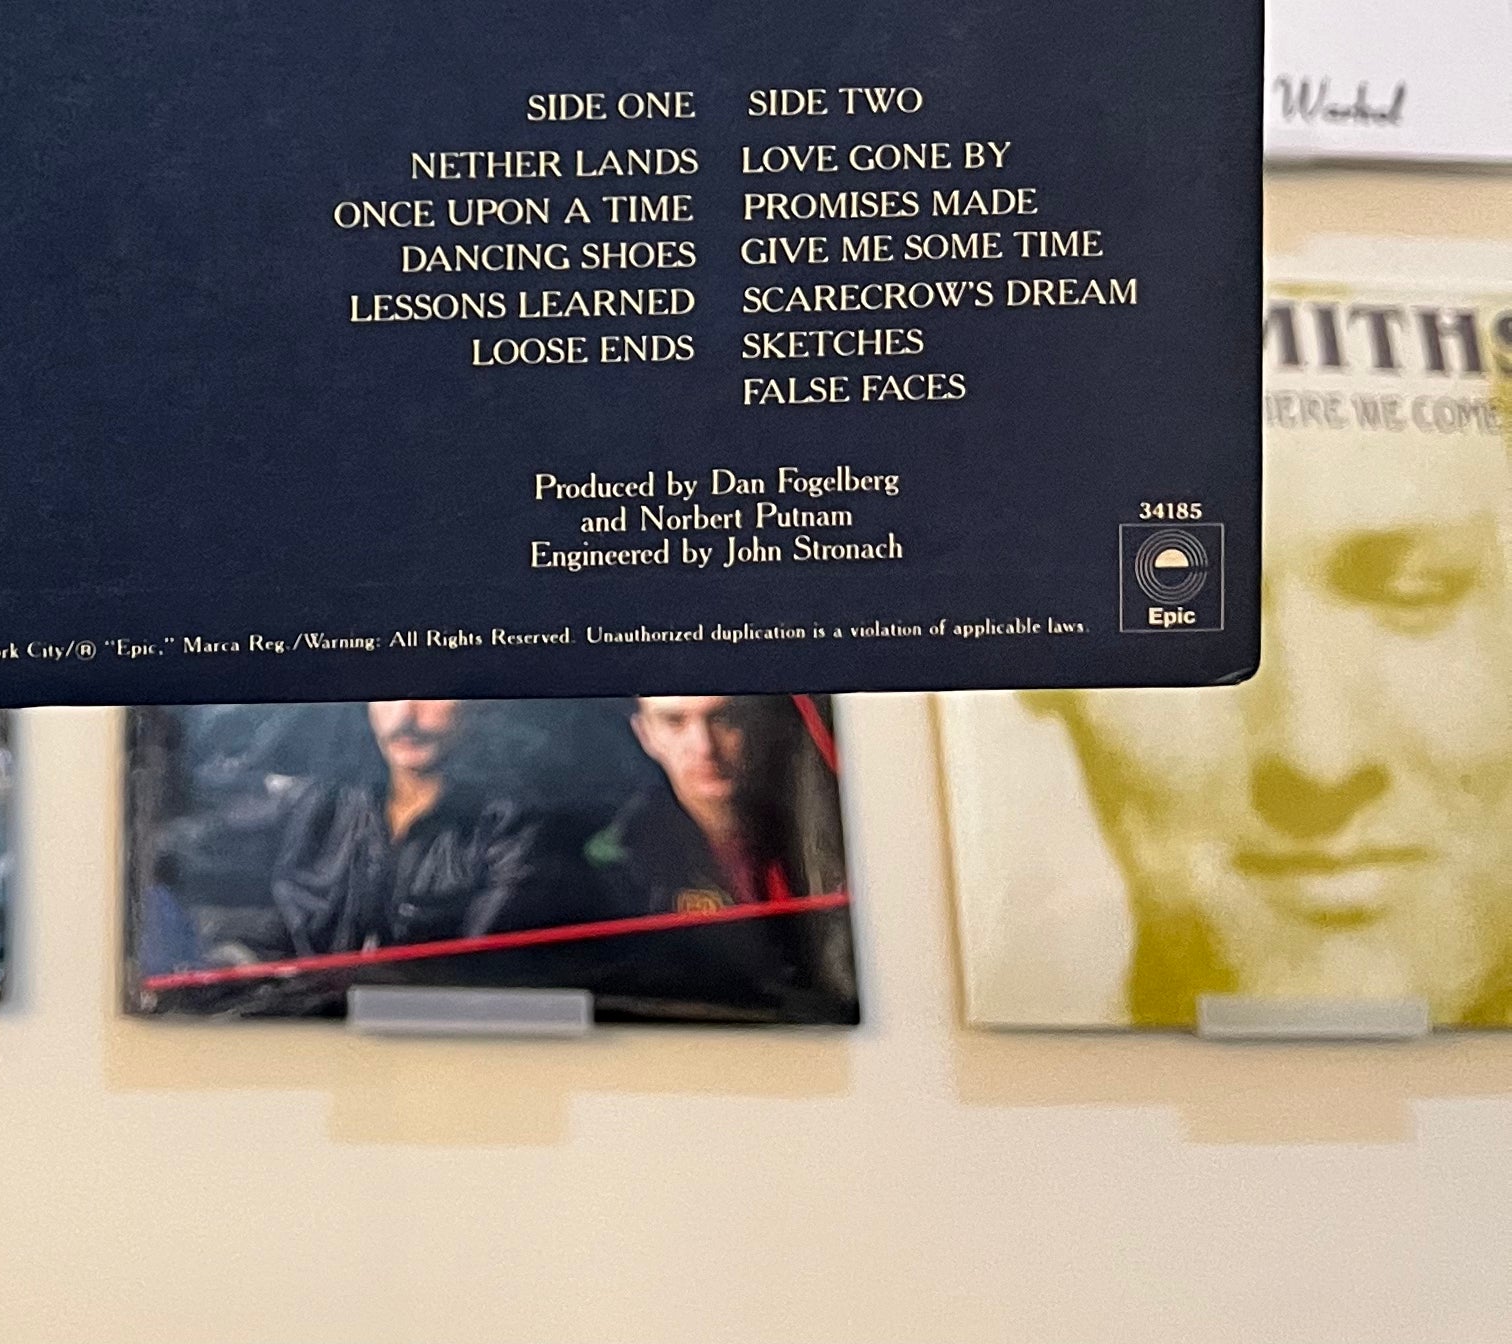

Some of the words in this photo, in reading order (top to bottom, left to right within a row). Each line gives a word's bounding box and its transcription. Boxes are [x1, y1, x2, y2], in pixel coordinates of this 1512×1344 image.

[527, 93, 607, 121] SIDE
[617, 91, 696, 119] ONE
[748, 88, 829, 117] SIDE
[838, 87, 923, 115] TWO
[411, 150, 563, 180] NETHER
[576, 148, 699, 177] LANDS
[742, 145, 839, 174] LOVE
[849, 142, 952, 171] GONE
[964, 141, 1011, 169] BY
[334, 200, 436, 229] ONCE
[447, 197, 550, 226] UPON
[564, 197, 591, 224] A
[602, 194, 694, 223] TIME
[744, 191, 920, 221] PROMISES
[932, 188, 1039, 217] MADE
[402, 243, 571, 273] DANCING
[580, 241, 697, 270] SHOES
[740, 236, 829, 265] GIVE
[841, 235, 894, 263] ME
[904, 232, 1003, 261] SOME
[1012, 230, 1104, 258] TIME
[350, 292, 507, 322] LESSONS
[518, 288, 695, 319] LEARNED
[742, 280, 994, 313] SCARECROW'S
[1006, 278, 1137, 306] DREAM
[472, 336, 589, 366] LOOSE
[600, 334, 695, 363] ENDS
[742, 328, 924, 359] SKETCHES
[743, 376, 850, 406] FALSE
[862, 373, 966, 402] FACES
[535, 470, 654, 500] Produced
[667, 470, 698, 501] by
[711, 468, 765, 495] Dan
[778, 465, 900, 498] Fogelberg
[580, 505, 627, 533] and
[640, 503, 742, 532] Norbert
[756, 501, 853, 529] Putnam
[1139, 502, 1203, 520] 34185
[531, 538, 669, 572] Engineered
[682, 537, 713, 569] by
[723, 535, 782, 568] John
[793, 532, 903, 561] Stronach
[1148, 607, 1195, 628] Epic
[183, 636, 240, 653] Marca
[389, 630, 418, 648] All
[426, 629, 483, 650] Rights
[492, 627, 576, 646] Reserved.
[586, 623, 704, 644] Unauthorized
[710, 622, 806, 644] duplication
[813, 623, 826, 639] is
[832, 627, 843, 638] a
[850, 619, 922, 638] violation
[929, 618, 947, 636] of
[953, 617, 1041, 639] applicable
